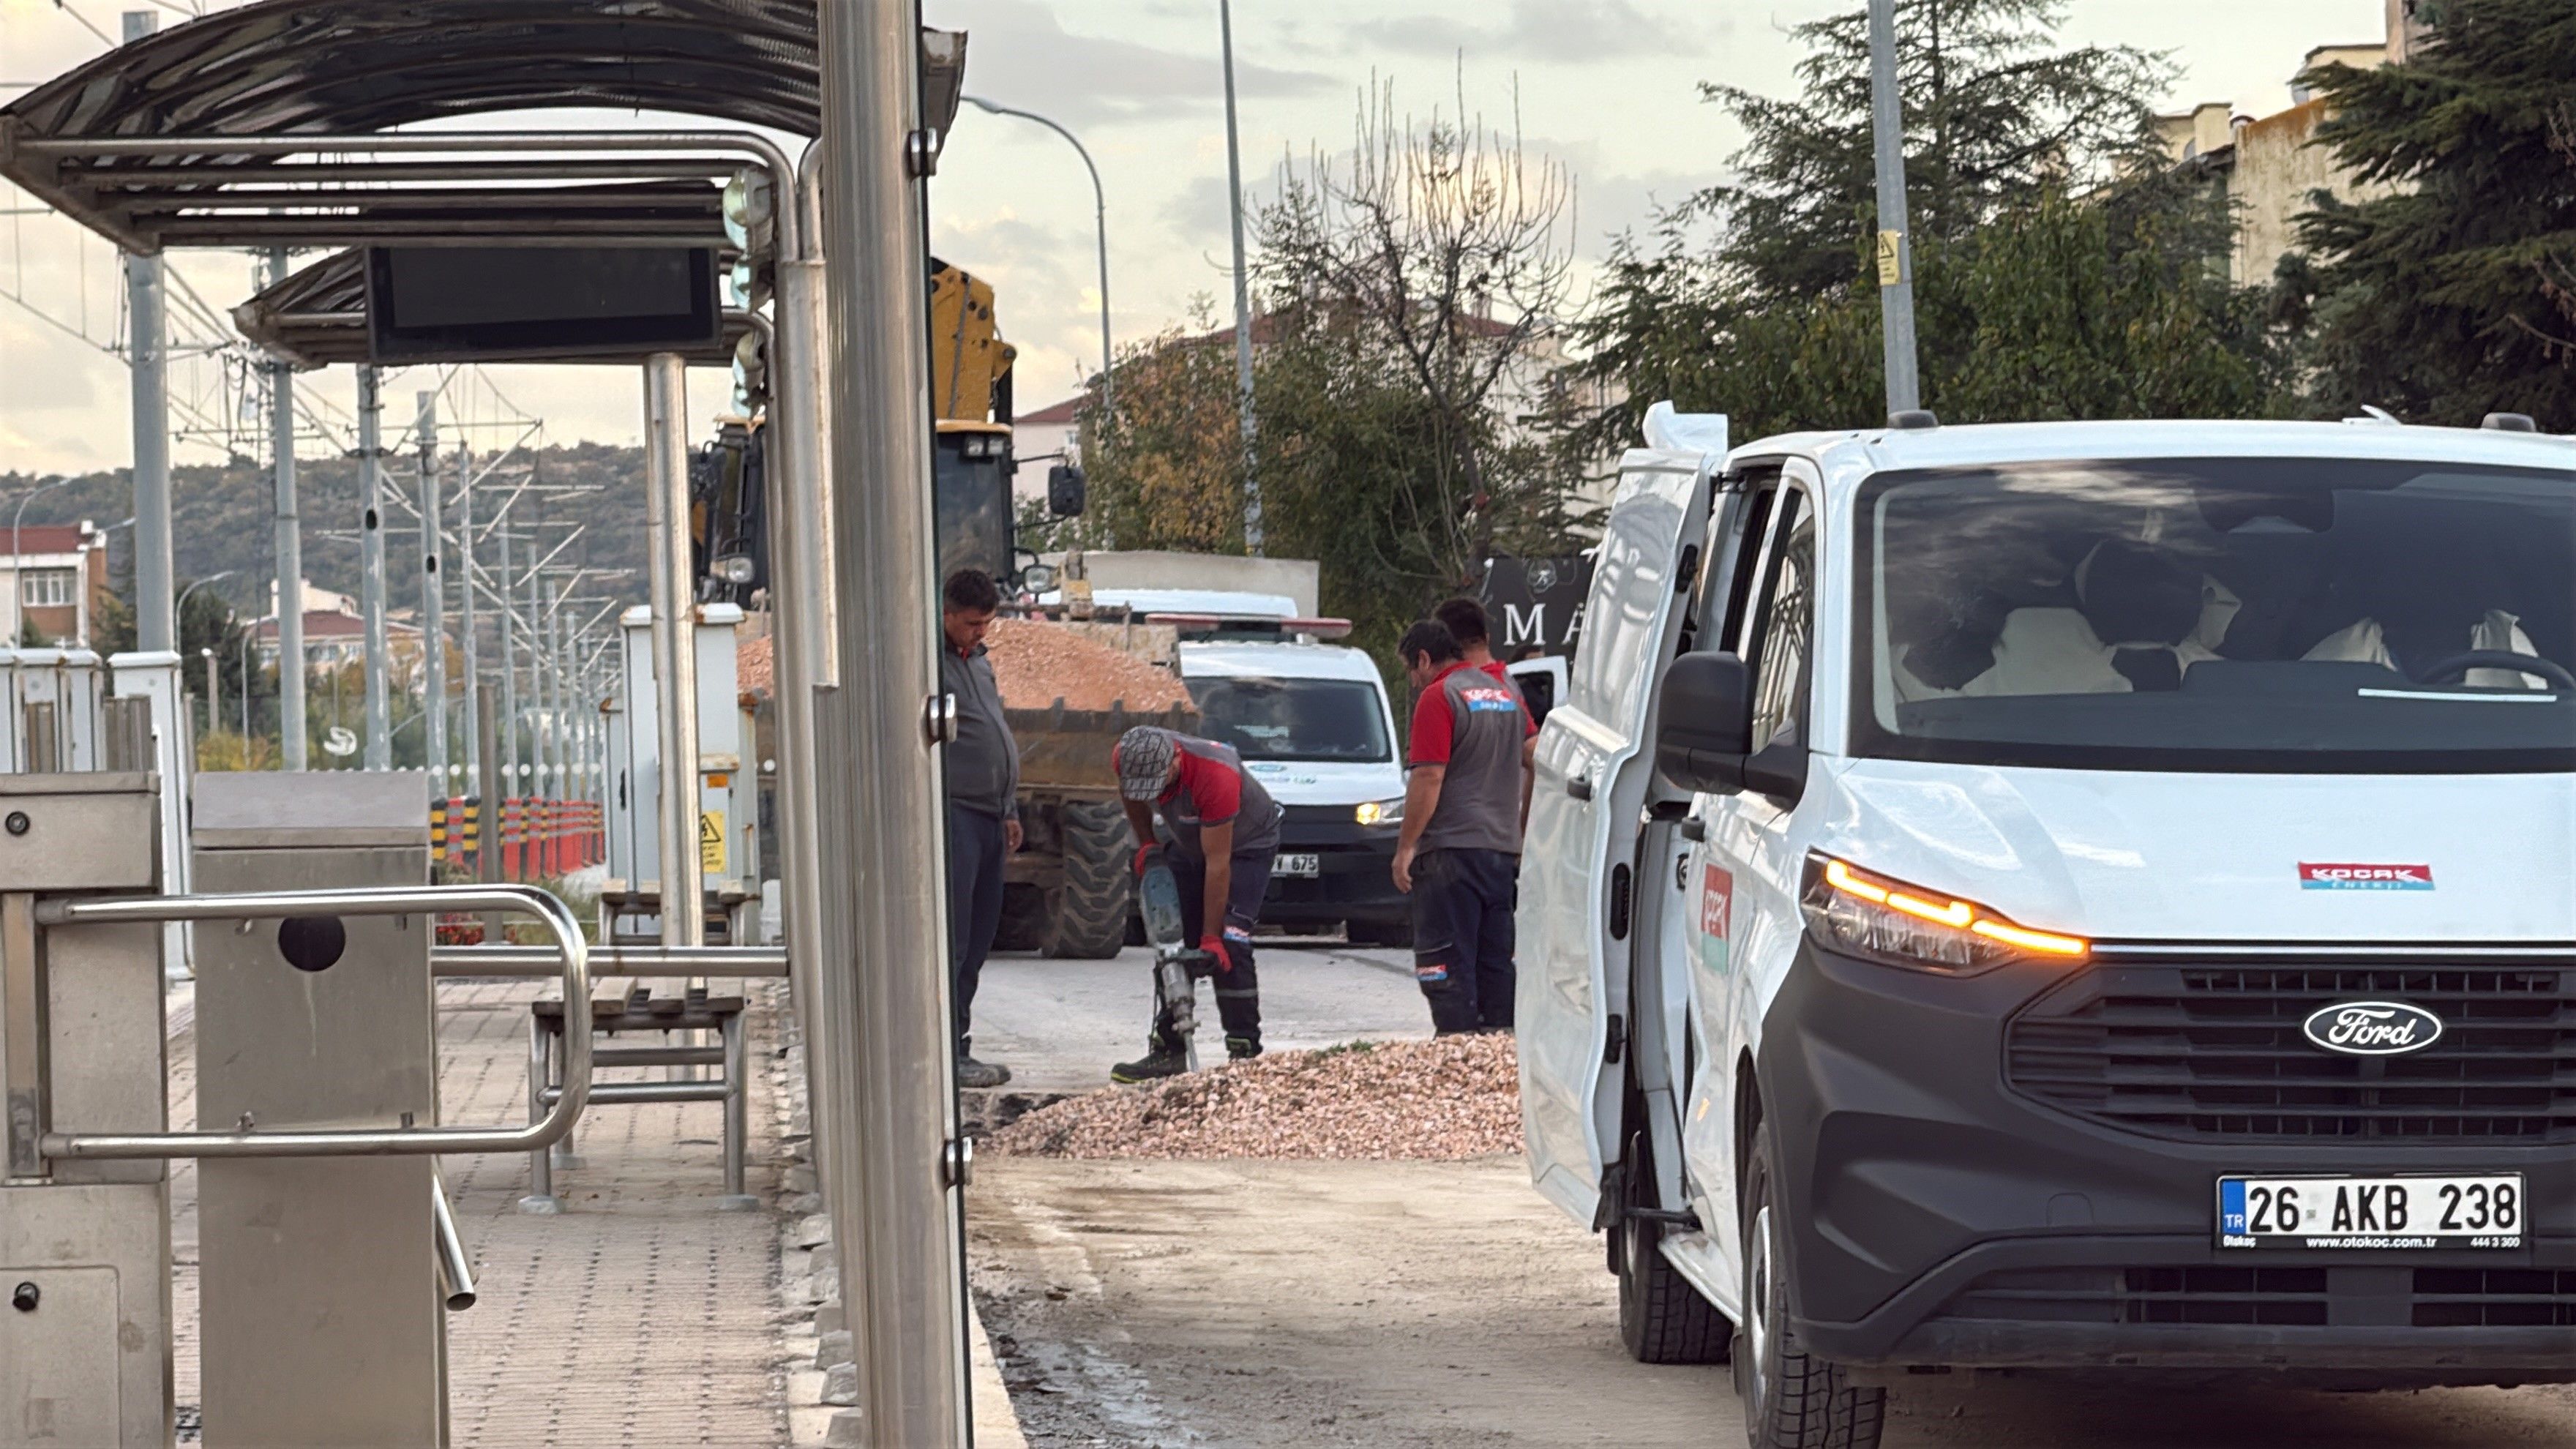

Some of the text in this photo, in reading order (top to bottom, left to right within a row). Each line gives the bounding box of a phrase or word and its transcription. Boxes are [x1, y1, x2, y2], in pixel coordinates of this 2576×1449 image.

[1292, 856, 1317, 871] 675
[2329, 1008, 2417, 1045] Ford
[2249, 1183, 2516, 1233] 26 AKB 238
[2225, 1214, 2244, 1229] TR
[2306, 1236, 2438, 1248] www.otokoc.com.tr
[2470, 1237, 2490, 1248] 444
[2501, 1237, 2520, 1248] 300
